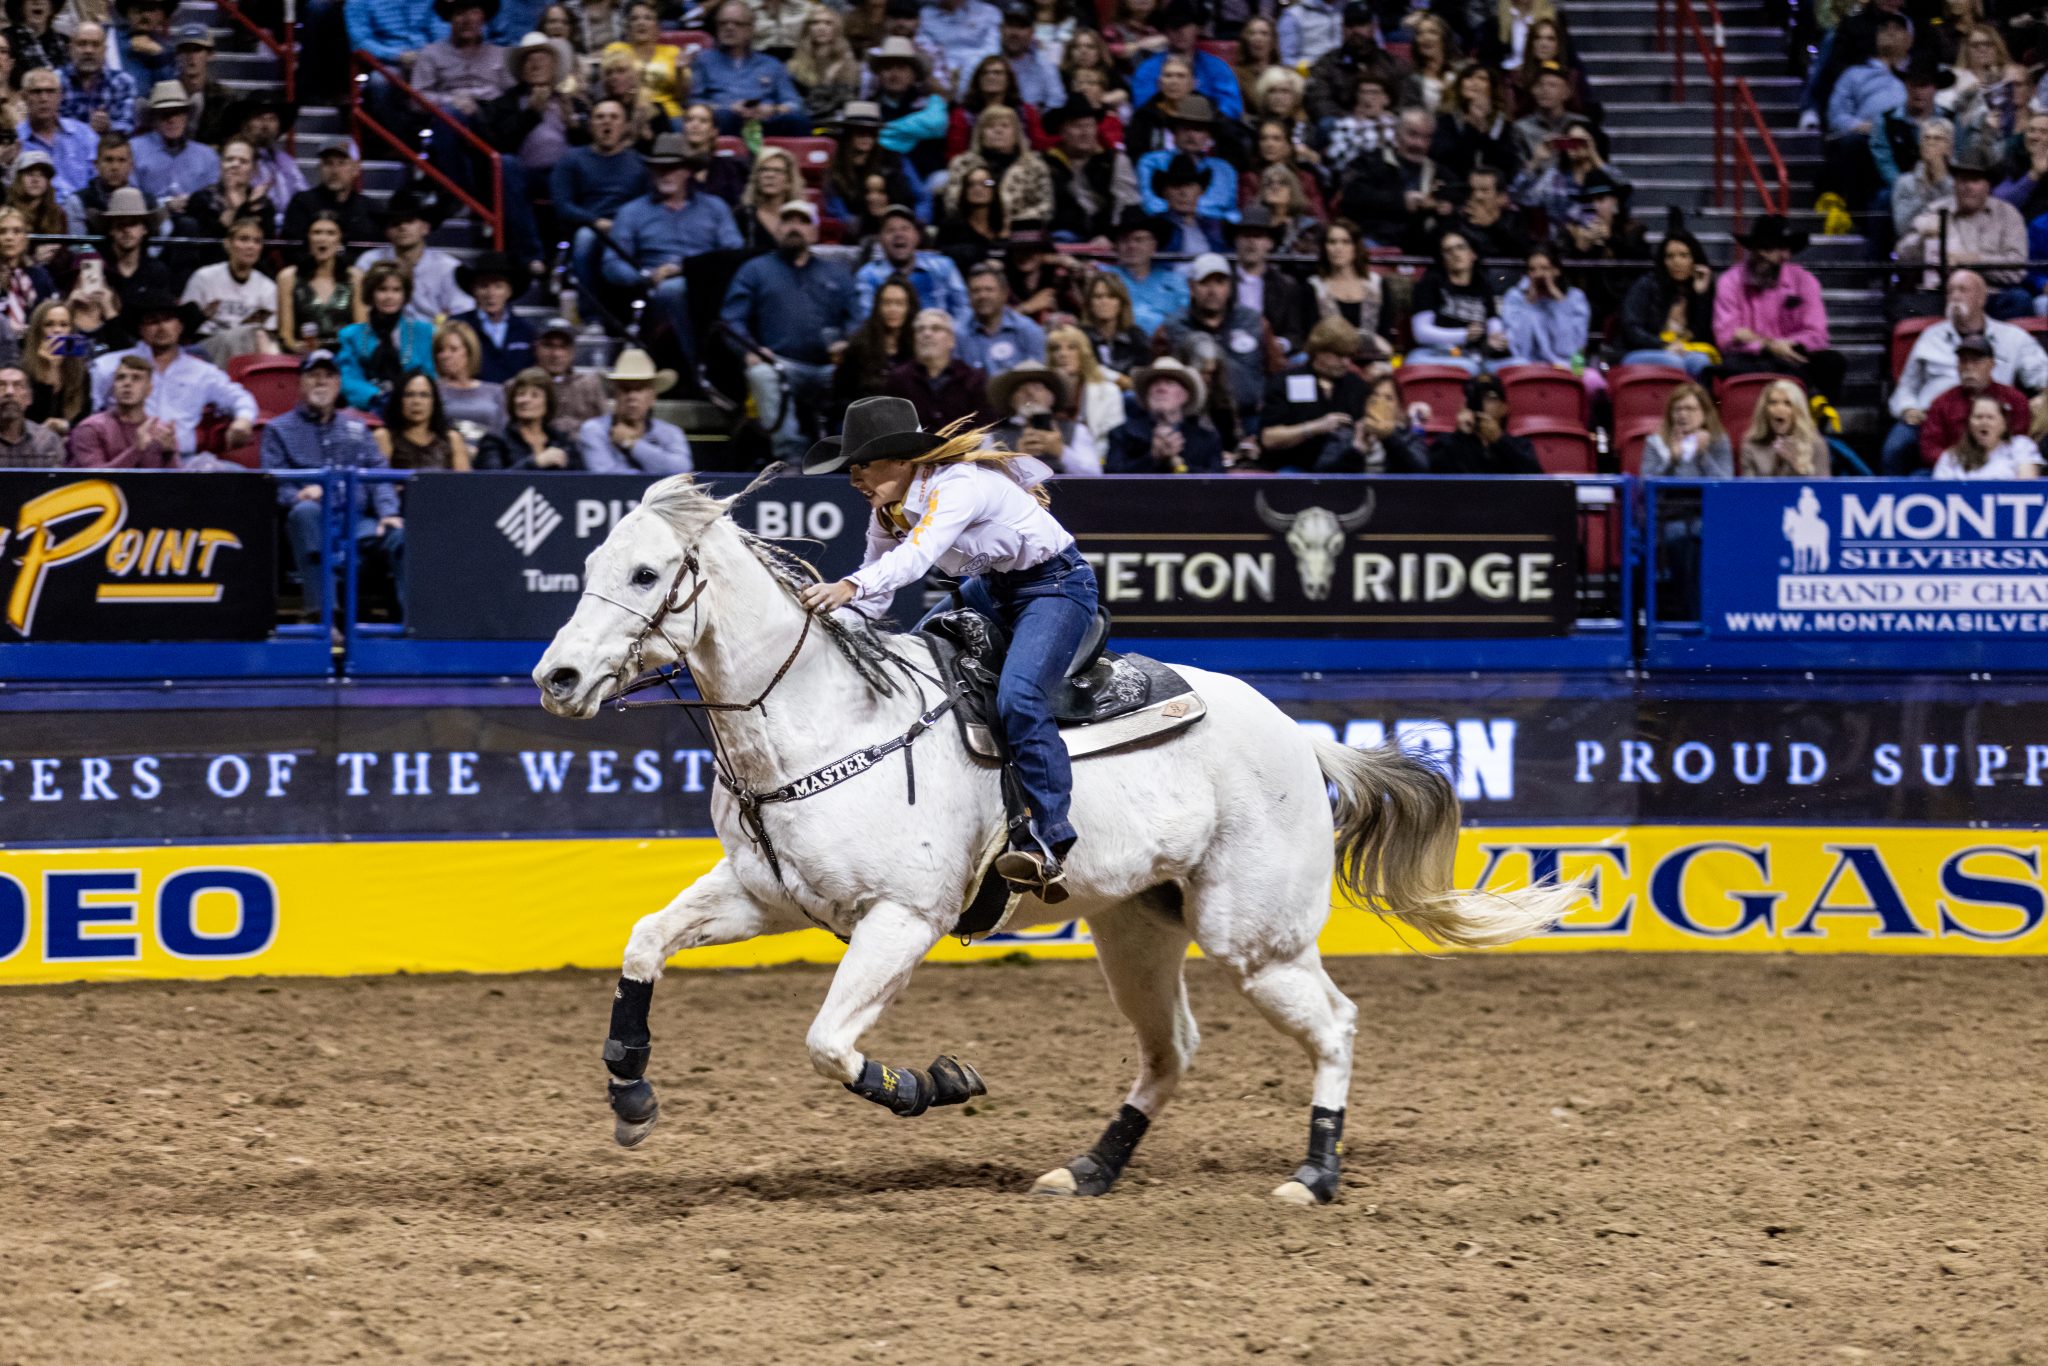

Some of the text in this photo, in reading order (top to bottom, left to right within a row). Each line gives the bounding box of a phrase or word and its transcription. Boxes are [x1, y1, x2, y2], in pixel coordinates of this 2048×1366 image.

[756, 500, 844, 540] BIO
[522, 569, 579, 592] Turn
[1081, 552, 1554, 602] ETON RIDGE
[1786, 583, 2048, 604] BRAND OF CHA
[207, 753, 298, 798] OF
[337, 751, 481, 797] THE
[519, 749, 713, 794] WEST
[792, 752, 871, 799] MASTER
[1575, 740, 1829, 785] PROUD
[0, 864, 280, 964] EO
